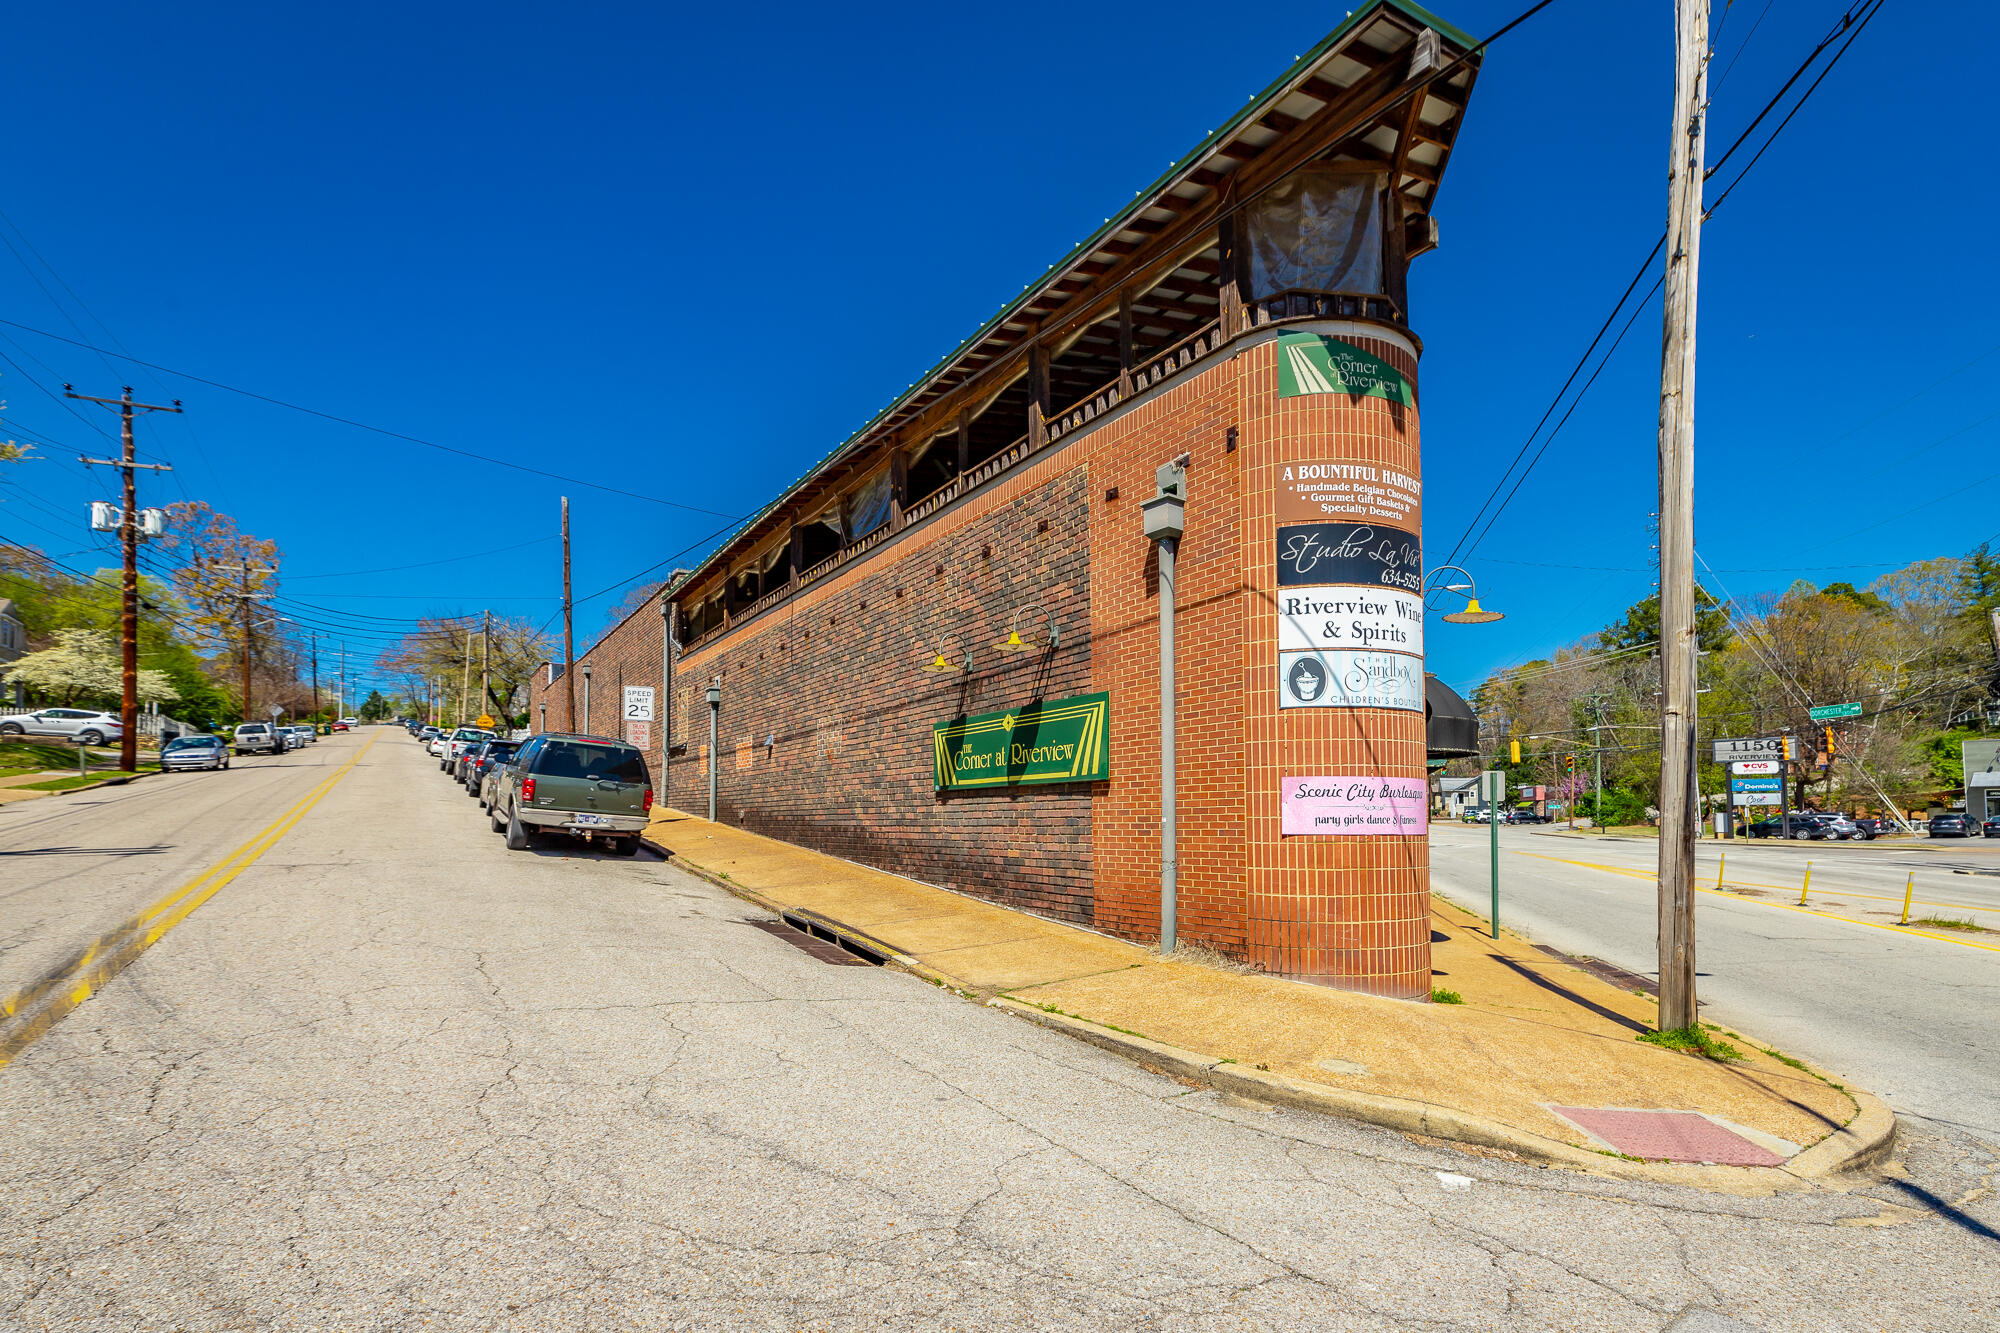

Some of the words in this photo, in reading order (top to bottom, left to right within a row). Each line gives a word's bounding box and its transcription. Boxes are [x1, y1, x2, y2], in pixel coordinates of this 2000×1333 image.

[1327, 356, 1378, 375] Corner
[1340, 353, 1354, 361] The
[1337, 370, 1398, 393] Riverview
[1282, 467, 1294, 481] A
[1298, 464, 1379, 482] BOUNTIFUL
[1382, 469, 1421, 496] HARVEST
[1296, 482, 1351, 493] Handmade
[1353, 483, 1386, 496] Belgian
[1386, 488, 1419, 507] Chocolates
[1310, 492, 1356, 503] Gourmet
[1357, 493, 1375, 505] Gift
[1376, 496, 1404, 511] Baskets
[1405, 502, 1410, 513] &
[1320, 503, 1368, 515] Specialty
[1369, 506, 1403, 520] Desserts
[1280, 526, 1374, 574] Studio
[1368, 540, 1400, 568] La
[1381, 568, 1420, 591] 634-5255
[1285, 596, 1388, 616] Riverview
[1394, 600, 1422, 623] Wine
[1323, 620, 1341, 638] &
[1351, 621, 1407, 646] Spirits
[1367, 656, 1388, 664] THE
[1345, 656, 1416, 692] Sandbox
[1330, 694, 1390, 705] CHILDREN'S
[628, 704, 650, 717] 25
[1811, 707, 1842, 717] DORCHESTER
[954, 751, 993, 771] Corner
[995, 747, 1007, 767] at
[1011, 739, 1075, 765] Riverview
[963, 743, 973, 754] THE
[1730, 740, 1778, 752] 1150
[1295, 784, 1343, 799] Scenic
[1346, 783, 1376, 801] City
[1380, 784, 1422, 802] Burlesque
[1315, 814, 1341, 827] party
[1344, 814, 1364, 827] girls
[1366, 815, 1391, 825] dance
[1399, 815, 1417, 825] fitness
